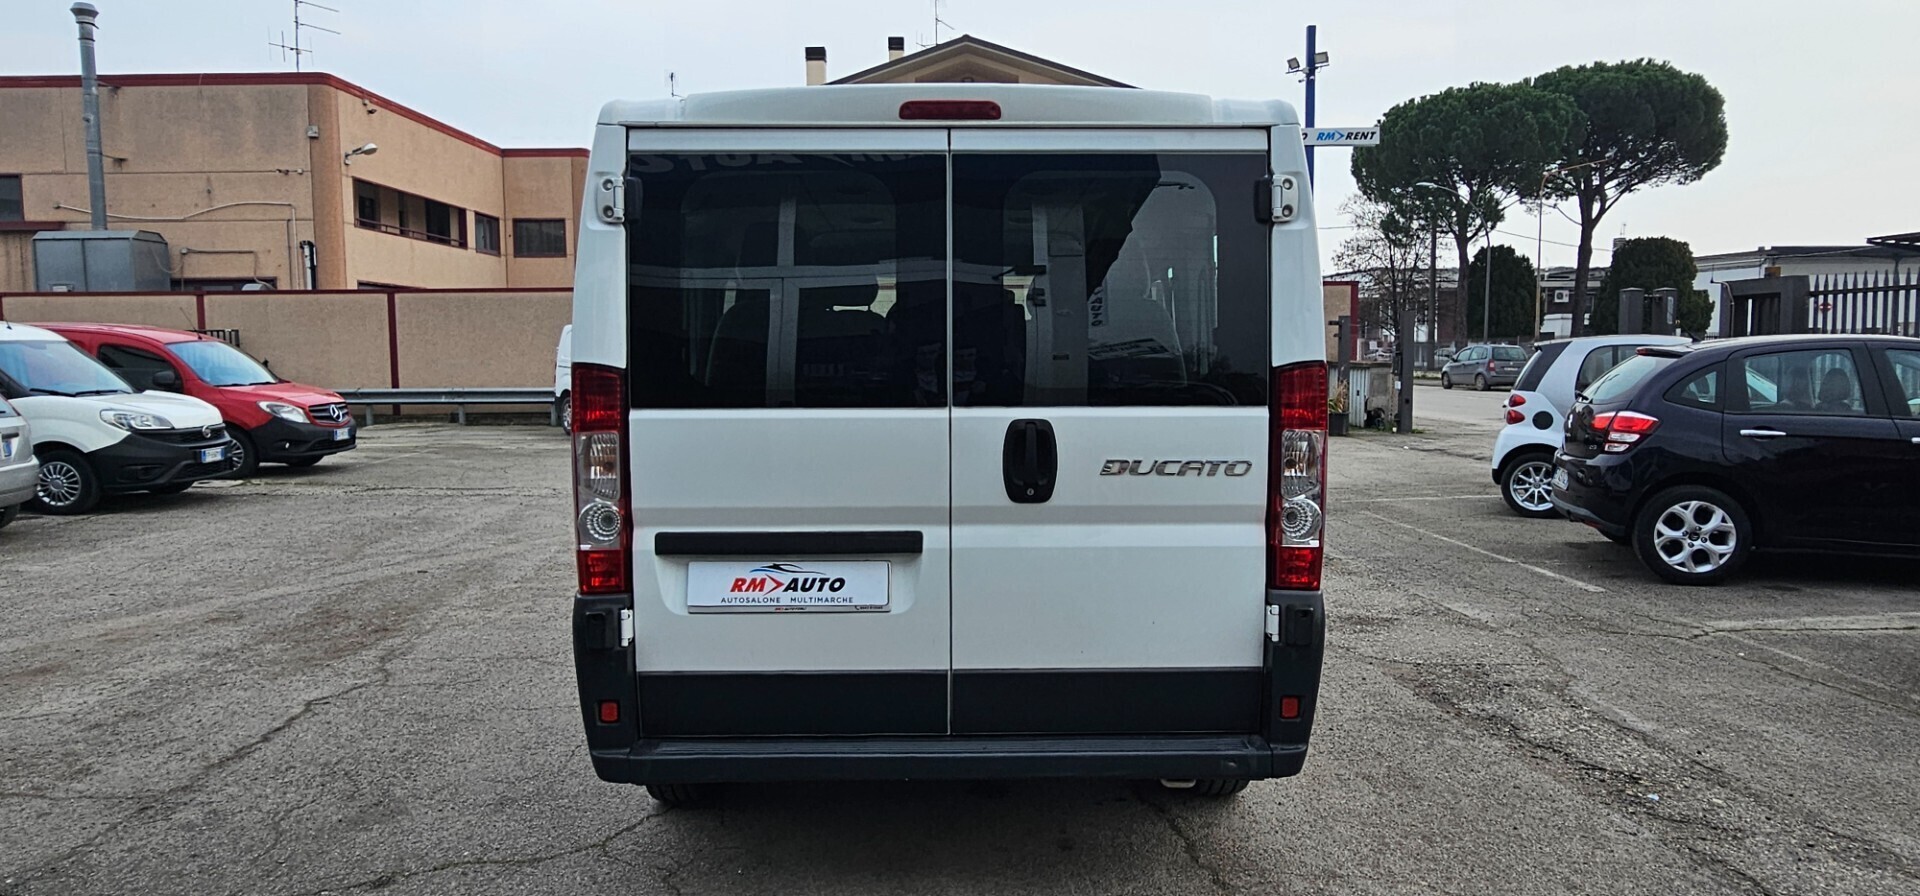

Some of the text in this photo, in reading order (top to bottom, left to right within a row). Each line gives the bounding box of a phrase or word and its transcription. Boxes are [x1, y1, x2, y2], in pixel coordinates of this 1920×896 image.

[1099, 459, 1253, 477] DUCATO
[720, 596, 854, 604] AUTOSALONE MULTIMARCHE
